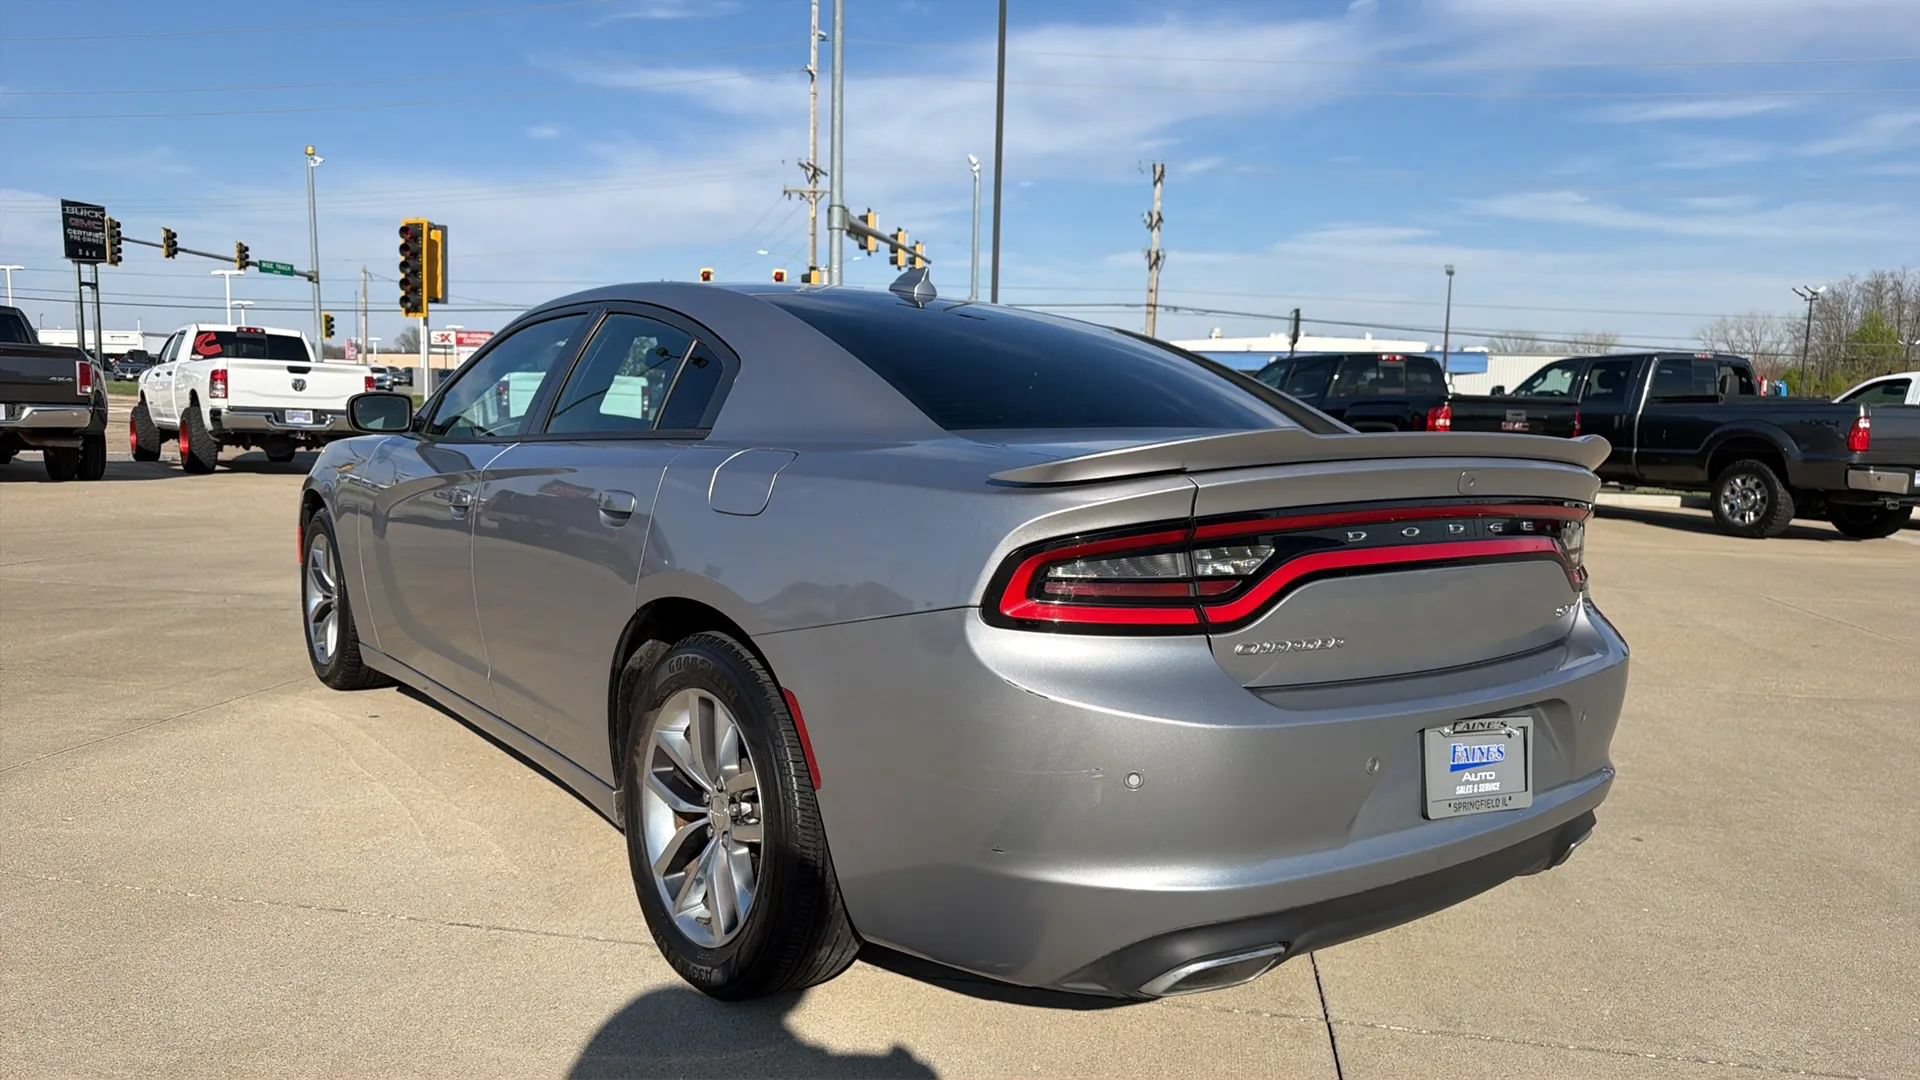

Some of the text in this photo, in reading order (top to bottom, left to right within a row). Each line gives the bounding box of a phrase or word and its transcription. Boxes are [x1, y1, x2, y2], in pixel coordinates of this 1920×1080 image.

[64, 206, 104, 219] BUICK
[69, 217, 103, 230] GMC
[67, 228, 105, 239] CERTIFIED
[69, 235, 104, 244] PRE-OWNED
[1346, 520, 1535, 544] DODGE
[1233, 637, 1345, 656] CHARGER
[1452, 720, 1508, 731] FAINE'S
[1462, 771, 1496, 782] AUTO
[1455, 781, 1501, 795] SALES & SERVICE
[1453, 797, 1509, 813] SPRINGFIELD IL
